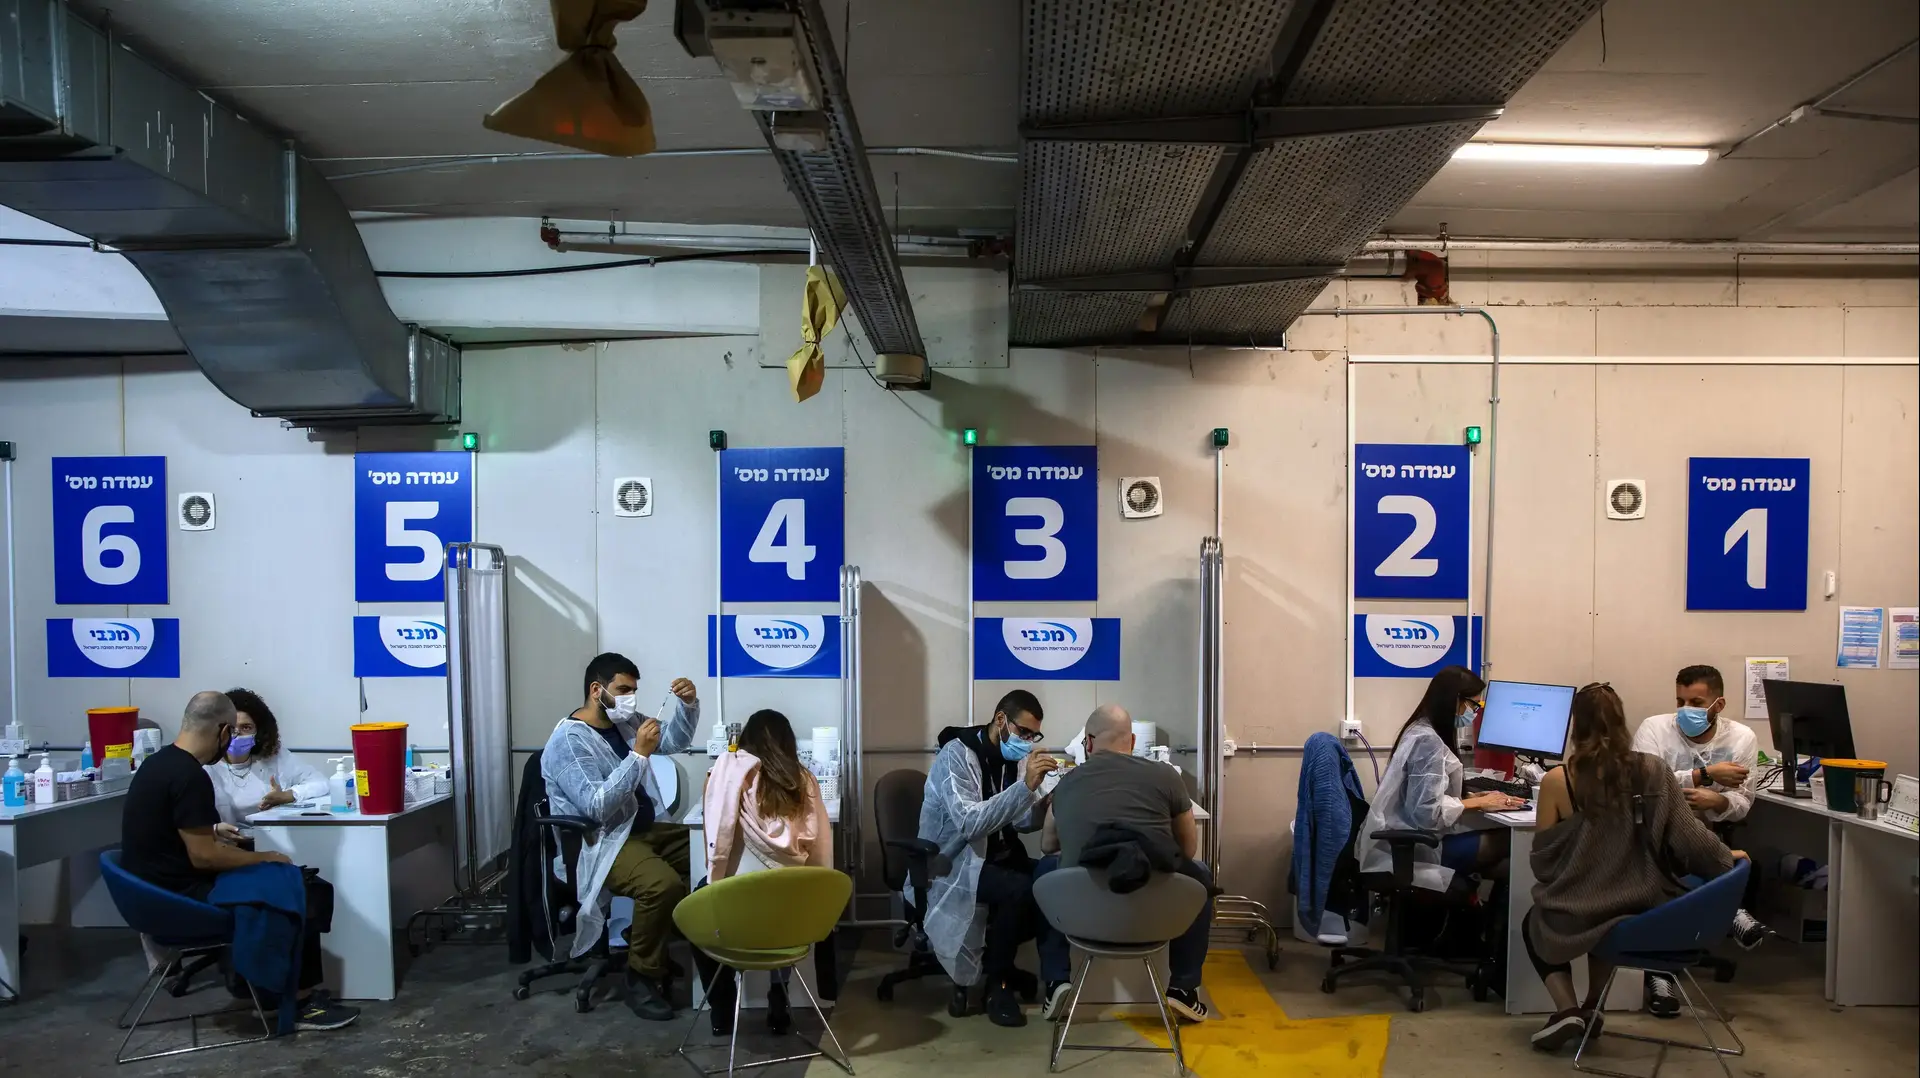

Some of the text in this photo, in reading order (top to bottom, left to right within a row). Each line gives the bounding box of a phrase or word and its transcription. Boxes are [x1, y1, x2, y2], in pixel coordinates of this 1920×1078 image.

[367, 471, 458, 484] עמדה מס'
[734, 467, 829, 481] עמדה מס'
[986, 465, 1083, 480] עמדה מס'
[1361, 463, 1455, 478] עמדה מס'
[65, 475, 153, 489] עמדה מס'
[1702, 476, 1795, 491] עמדה מס'
[385, 501, 443, 581] 5
[749, 499, 816, 580] 4
[1004, 497, 1066, 579] 3
[1375, 495, 1438, 576] 2
[82, 506, 140, 585] 6
[1724, 508, 1767, 589] 1
[89, 630, 129, 641] מכבי
[397, 629, 438, 639] מכבי
[754, 628, 797, 639] מכבי
[1021, 630, 1064, 641] מכבי
[1384, 628, 1427, 639] מכבי
